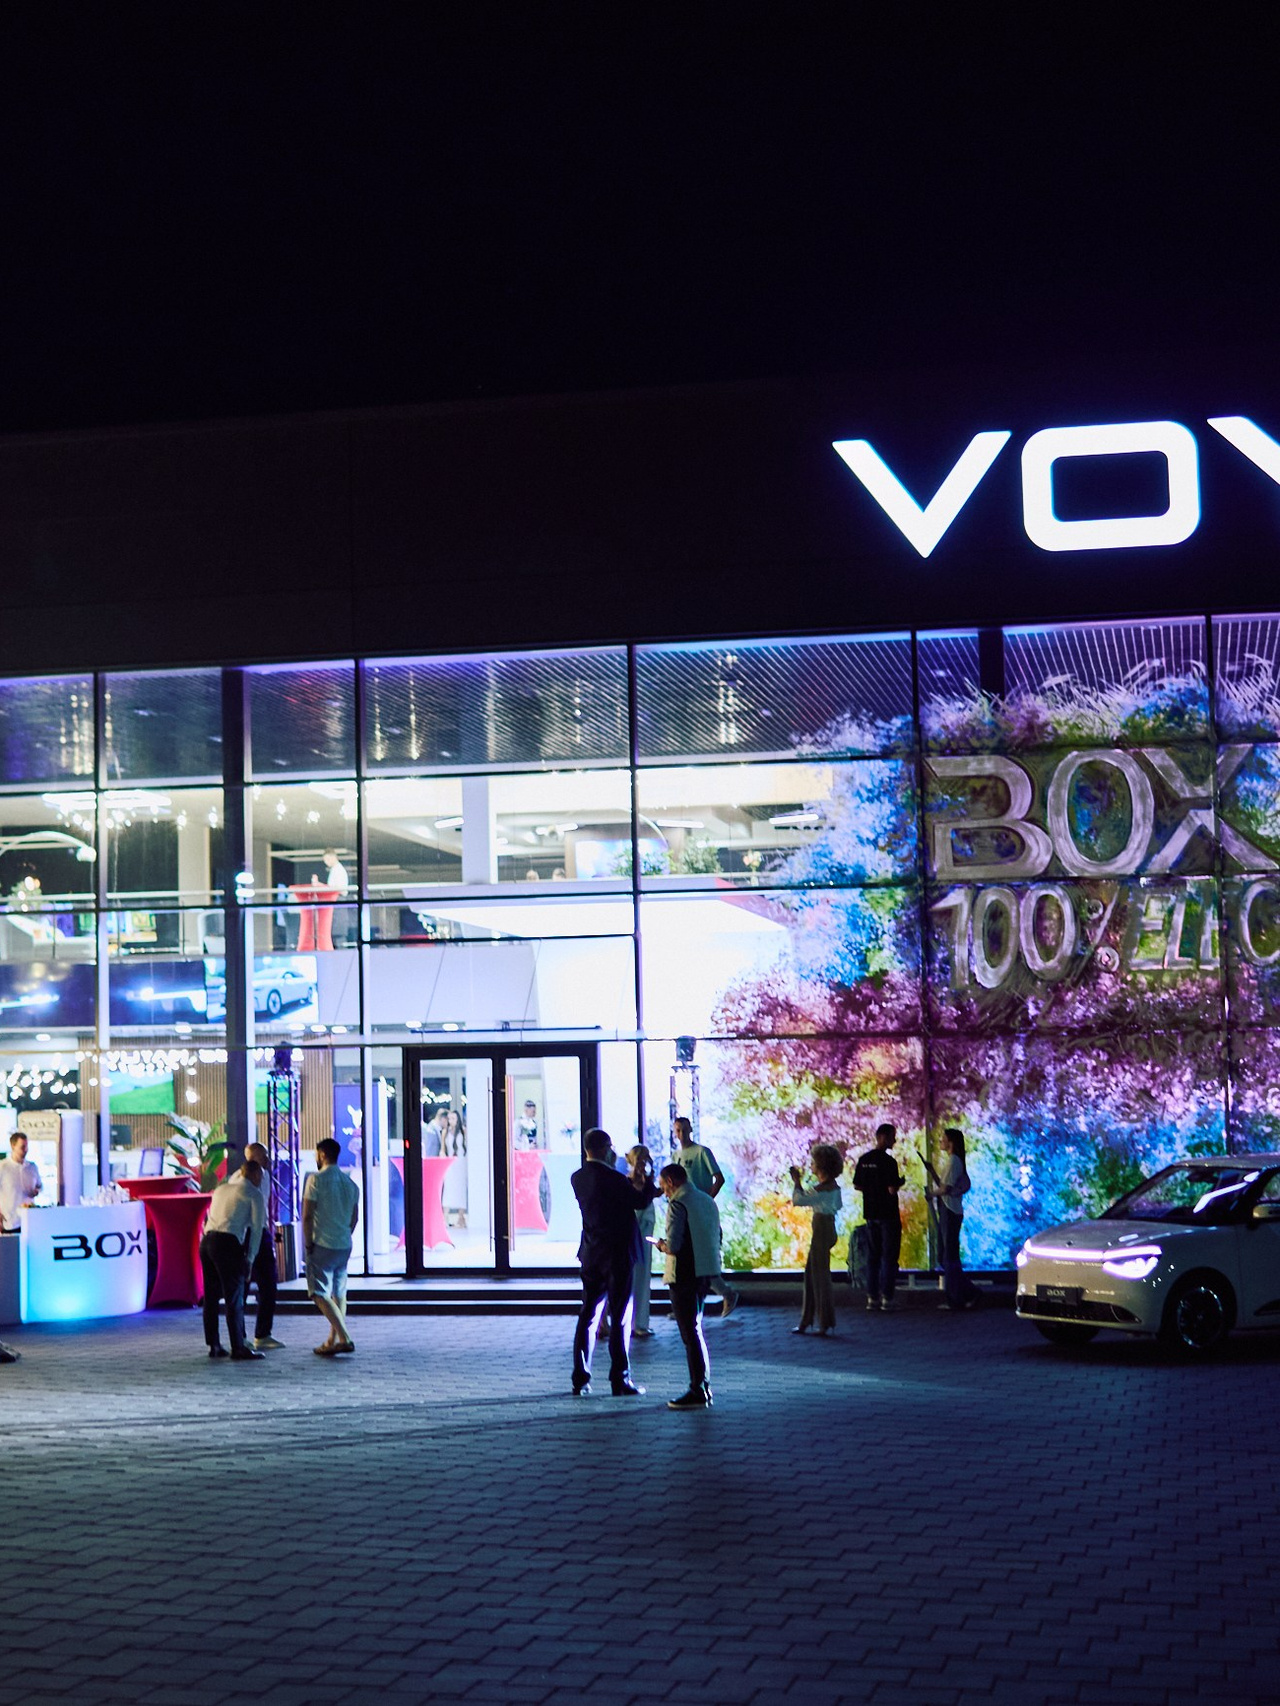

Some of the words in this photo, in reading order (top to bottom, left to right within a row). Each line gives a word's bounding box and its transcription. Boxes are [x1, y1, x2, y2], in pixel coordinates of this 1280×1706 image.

[923, 745, 1280, 880] BOX
[929, 883, 1120, 990] 100%
[51, 1229, 143, 1261] BOX
